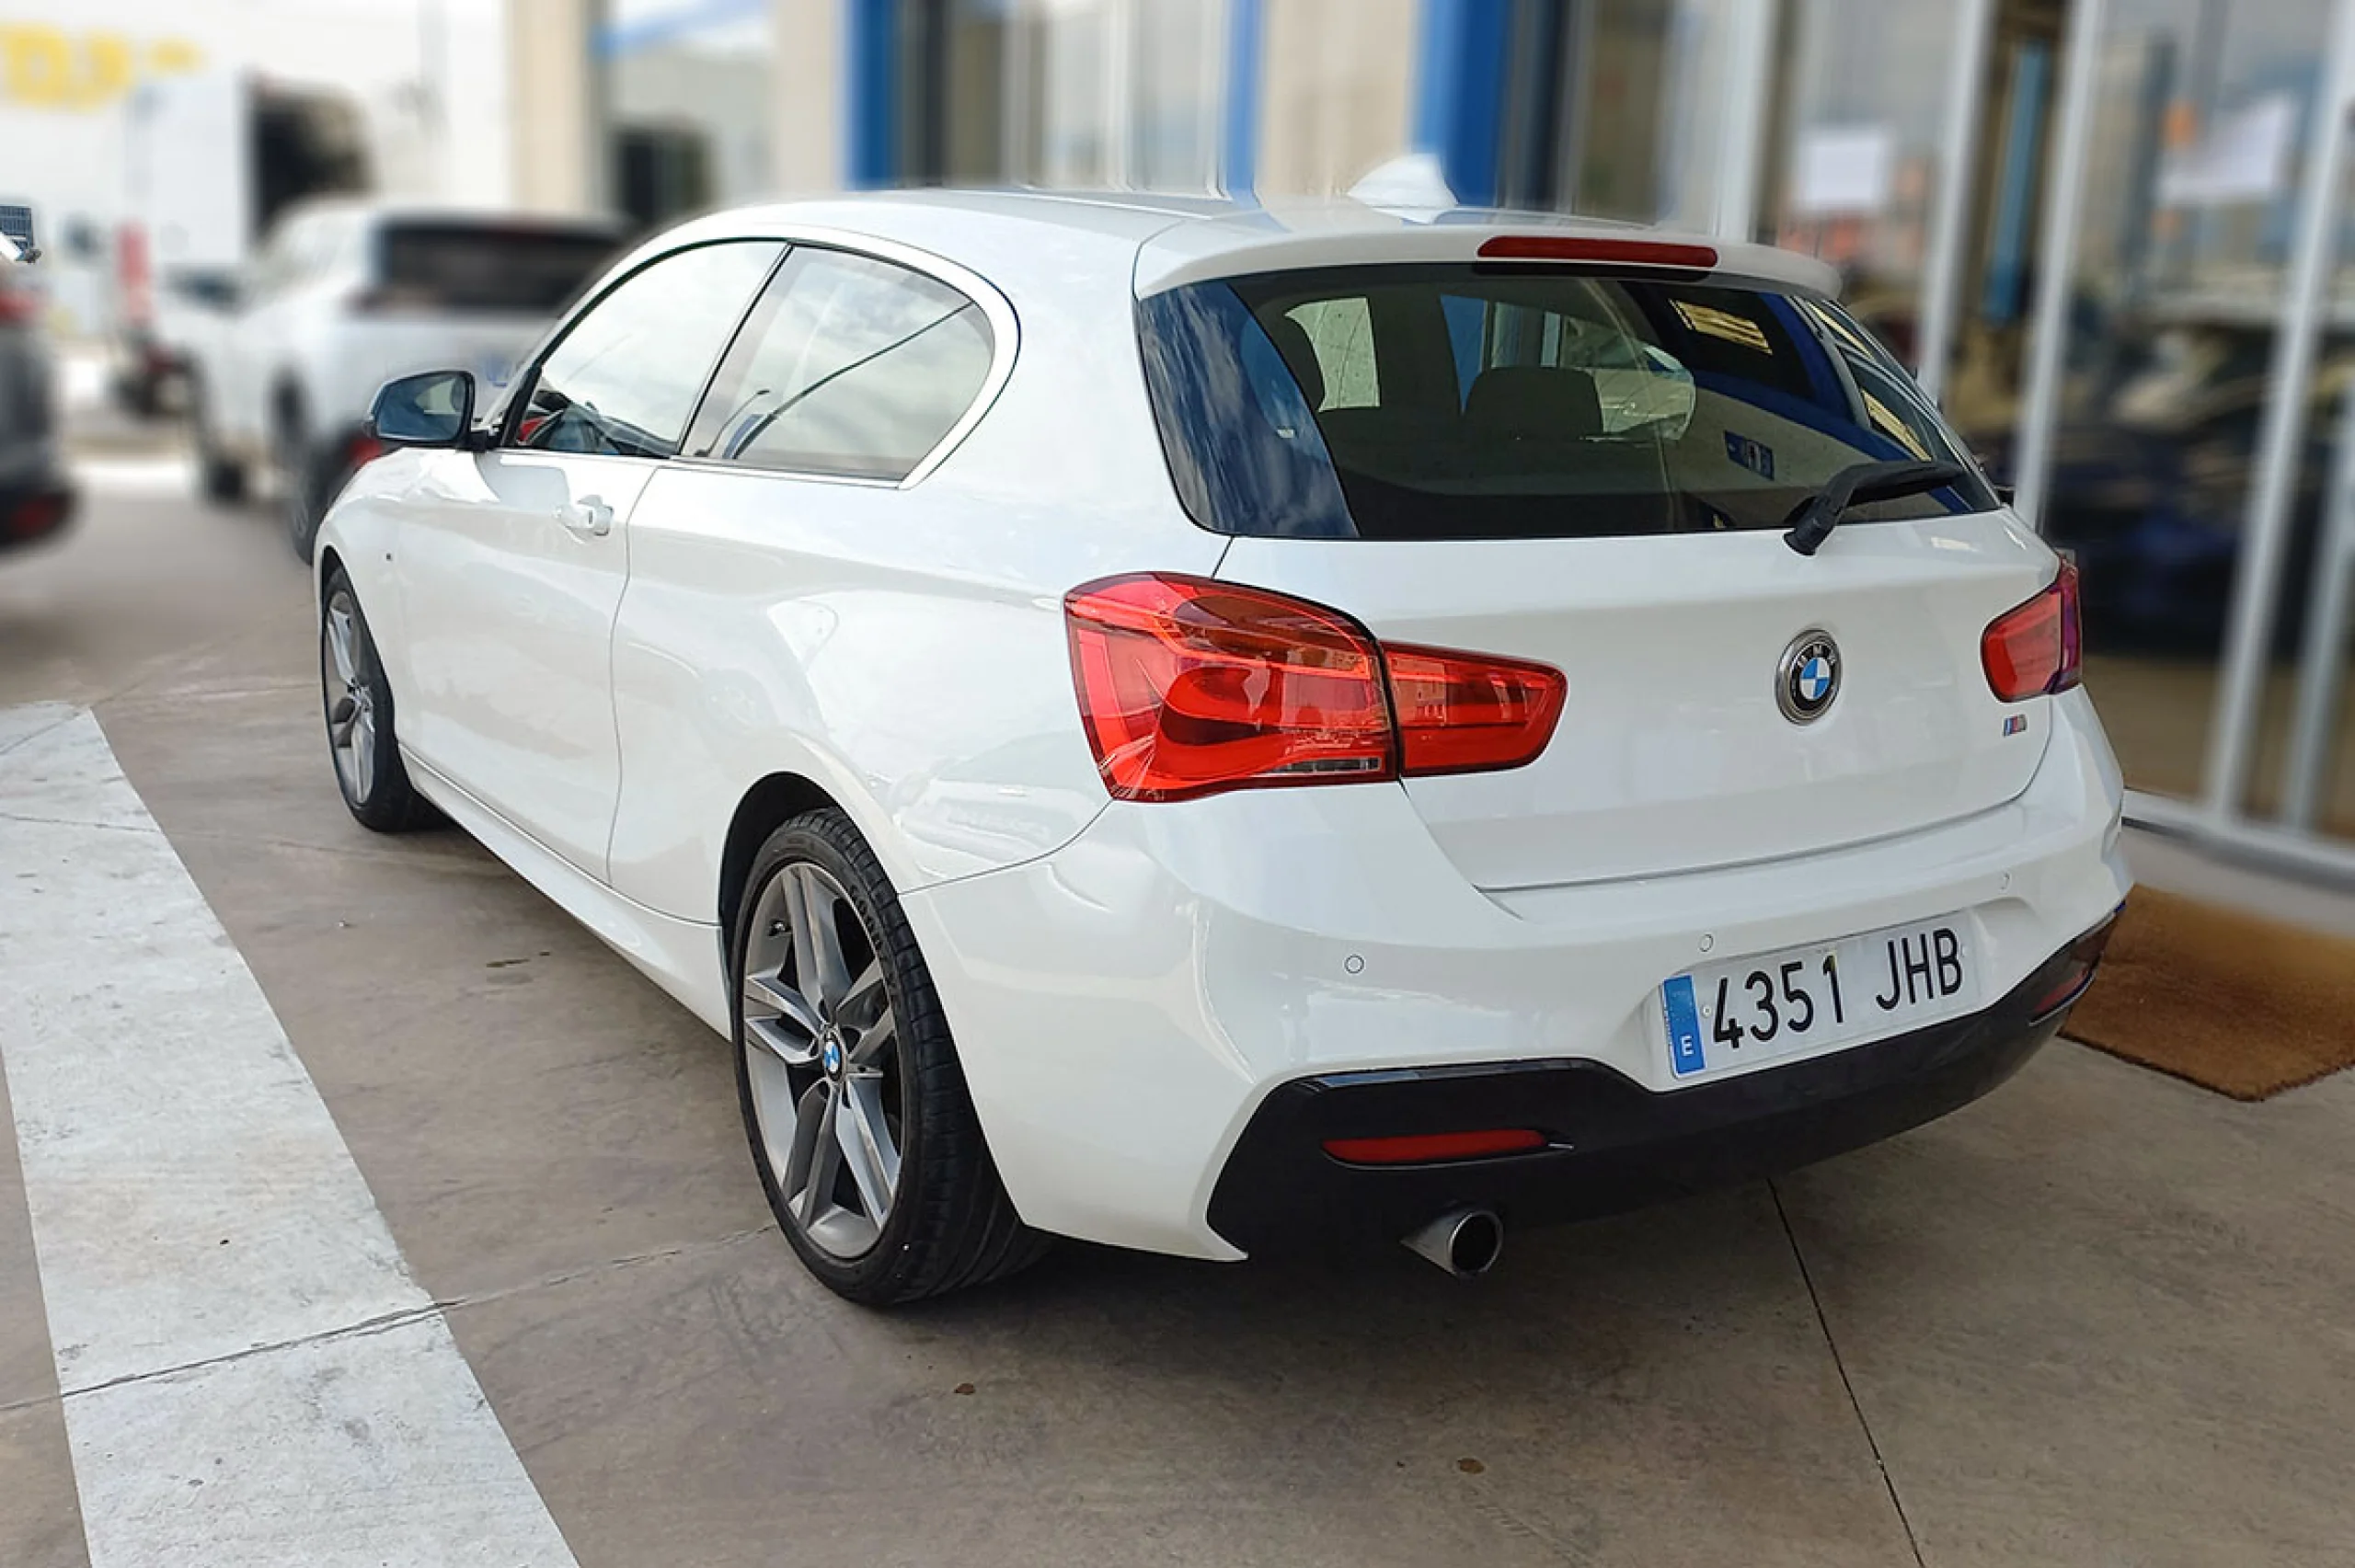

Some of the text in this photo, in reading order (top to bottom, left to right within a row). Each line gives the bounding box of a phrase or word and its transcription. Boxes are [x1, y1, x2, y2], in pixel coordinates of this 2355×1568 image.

[1714, 928, 1962, 1048] 4351 JHB
[1680, 1036, 1694, 1057] E
